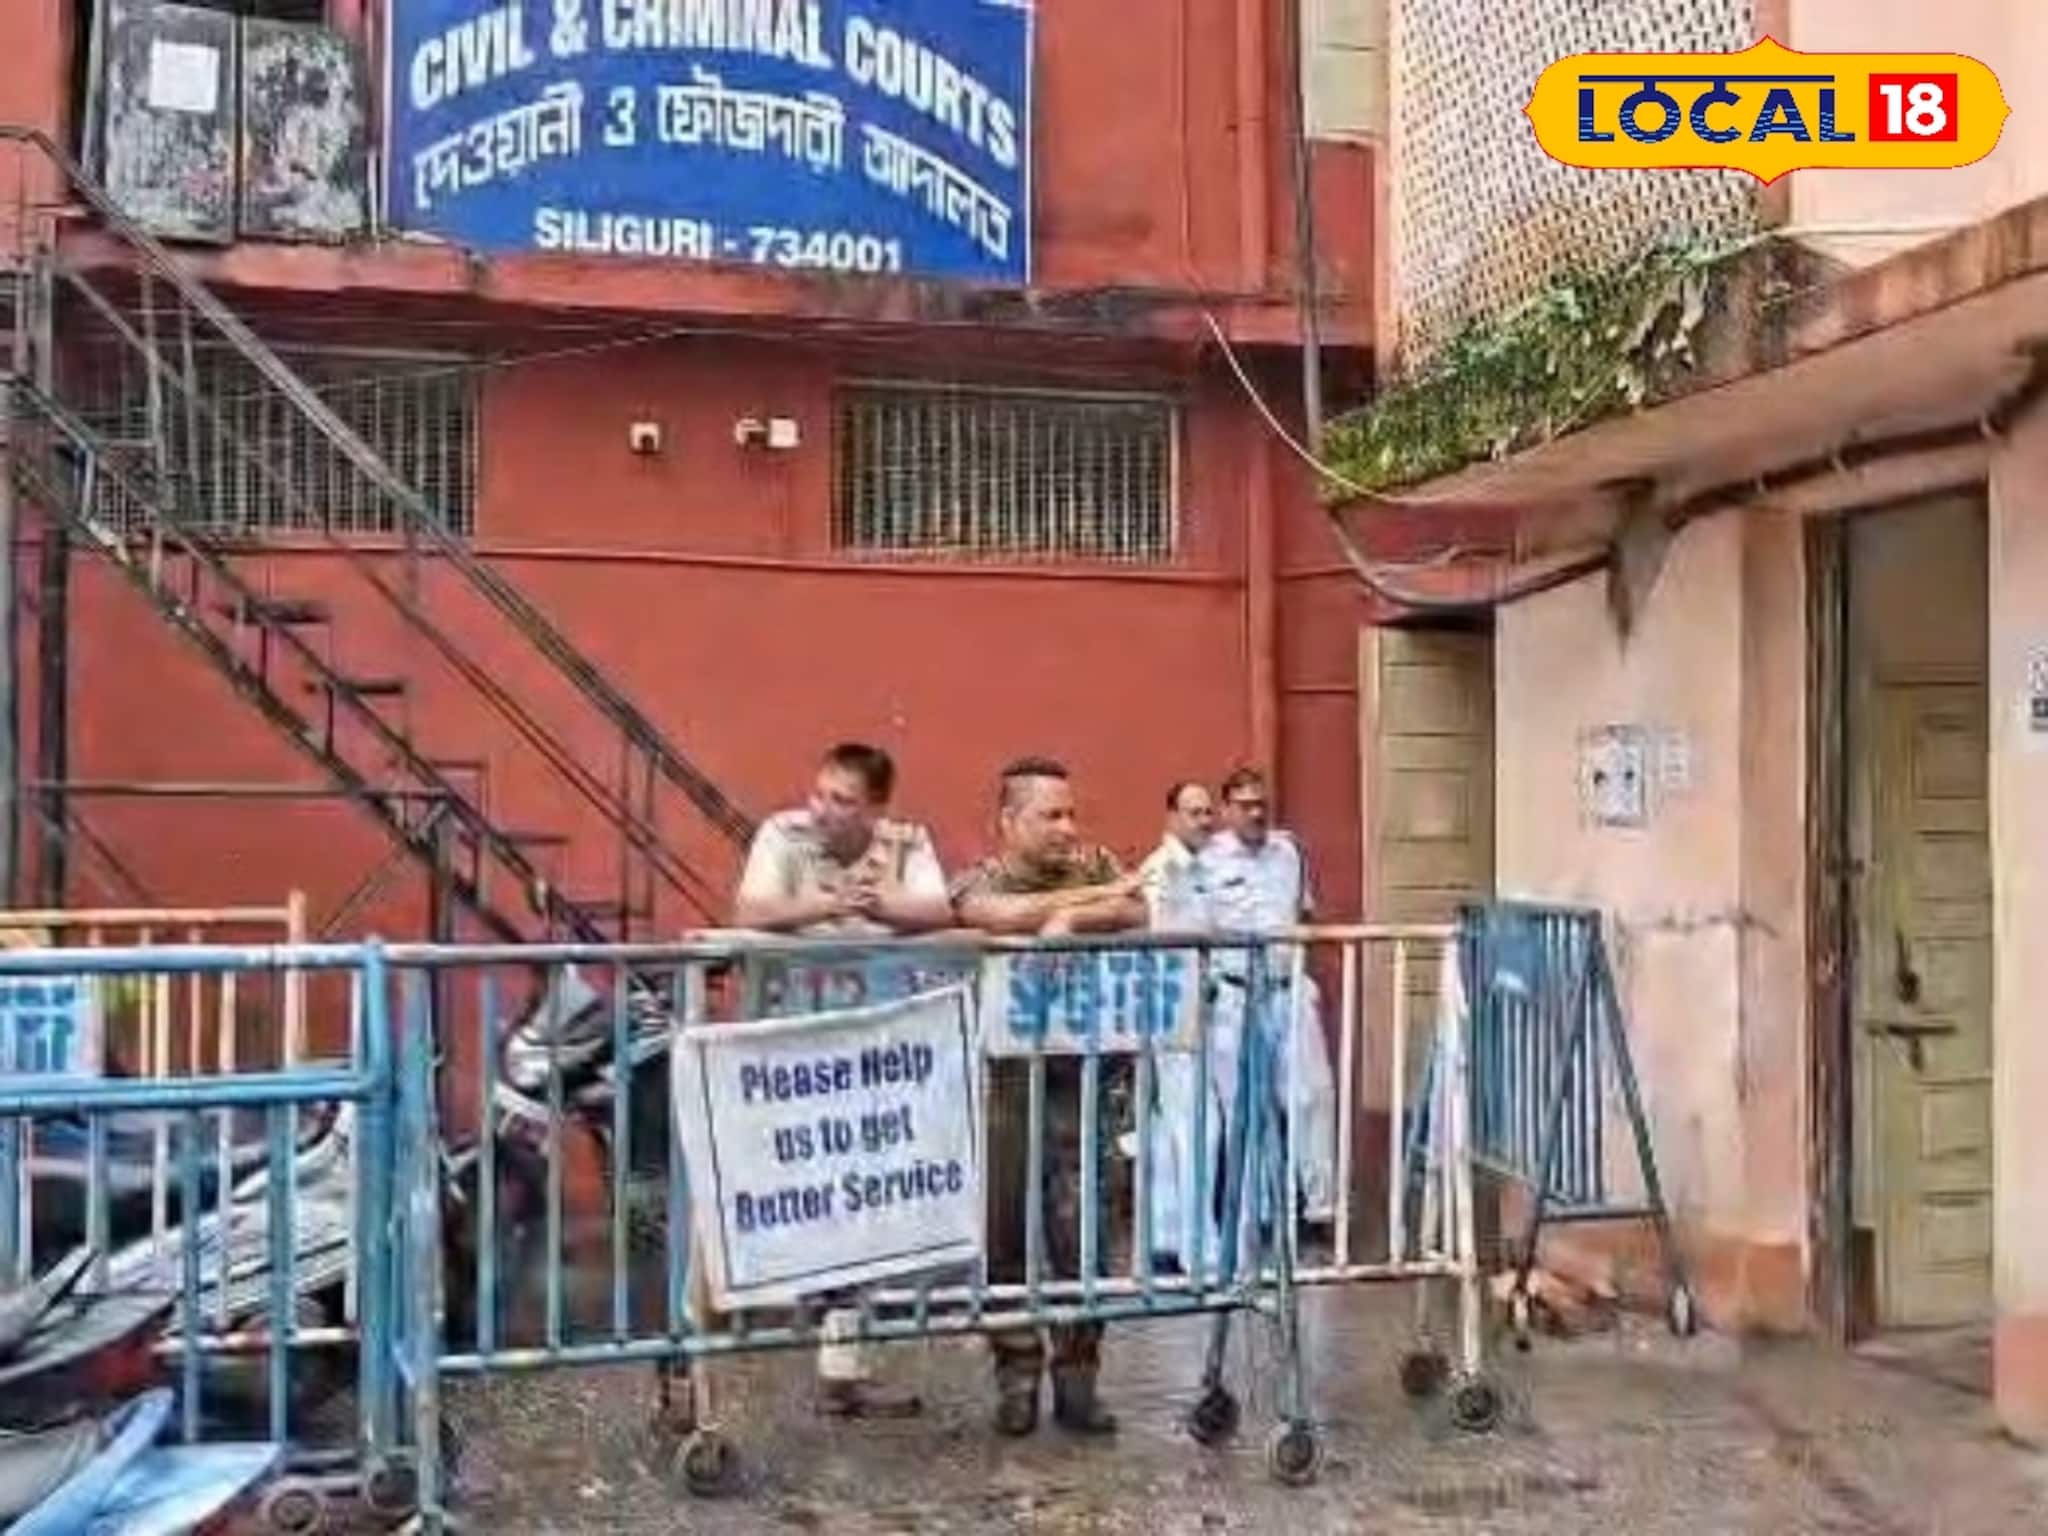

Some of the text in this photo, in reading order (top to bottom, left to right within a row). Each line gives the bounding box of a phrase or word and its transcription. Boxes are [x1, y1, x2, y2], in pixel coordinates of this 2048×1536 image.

[410, 0, 1018, 168] CIVIL & CRIMINAL COURTS
[862, 122, 1012, 262] আদালত
[533, 206, 712, 259] SILIGURI
[748, 226, 901, 272] 734001
[740, 1043, 933, 1104] Please Help
[775, 1104, 915, 1163] us to get
[842, 1159, 964, 1213] Service
